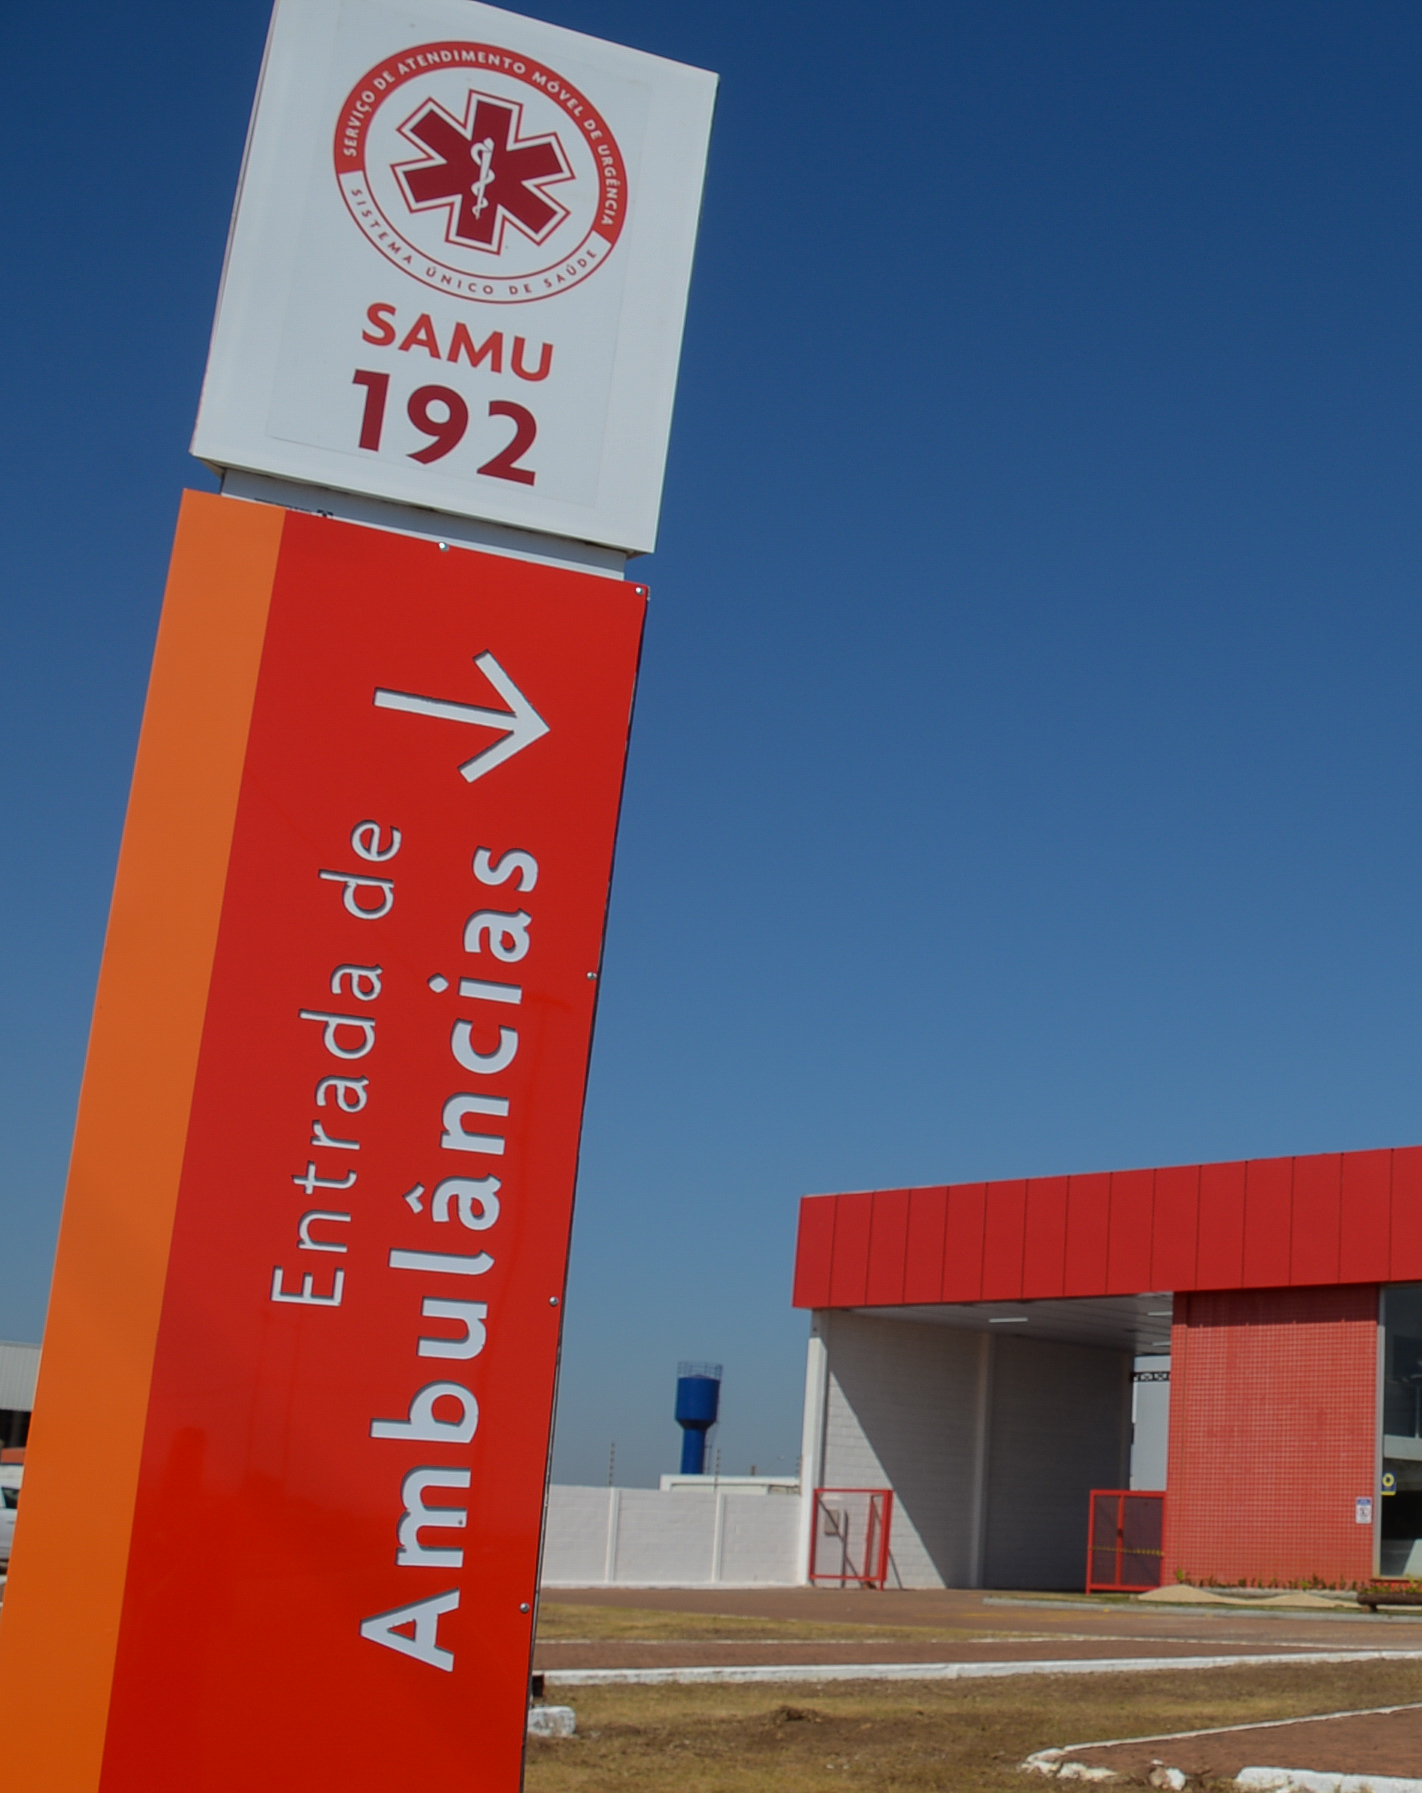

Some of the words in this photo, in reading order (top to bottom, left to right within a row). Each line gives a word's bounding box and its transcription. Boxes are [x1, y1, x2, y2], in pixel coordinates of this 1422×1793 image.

[343, 90, 376, 157] SERVIÇO
[373, 70, 396, 91] DE
[397, 49, 526, 75] ATENDIMENTO
[532, 71, 584, 117] MÓVEL
[584, 119, 603, 140] DE
[597, 144, 619, 226] URGÊNCIA
[351, 188, 413, 265] SISTEMA
[426, 265, 494, 295] ÚNICO
[509, 283, 532, 295] DE
[543, 249, 597, 289] SAÚDE
[362, 302, 553, 382] SAMU
[352, 368, 537, 486] 192
[318, 819, 402, 920] de
[271, 963, 383, 1306] Entrada
[360, 845, 538, 1673] Ambulâncias
